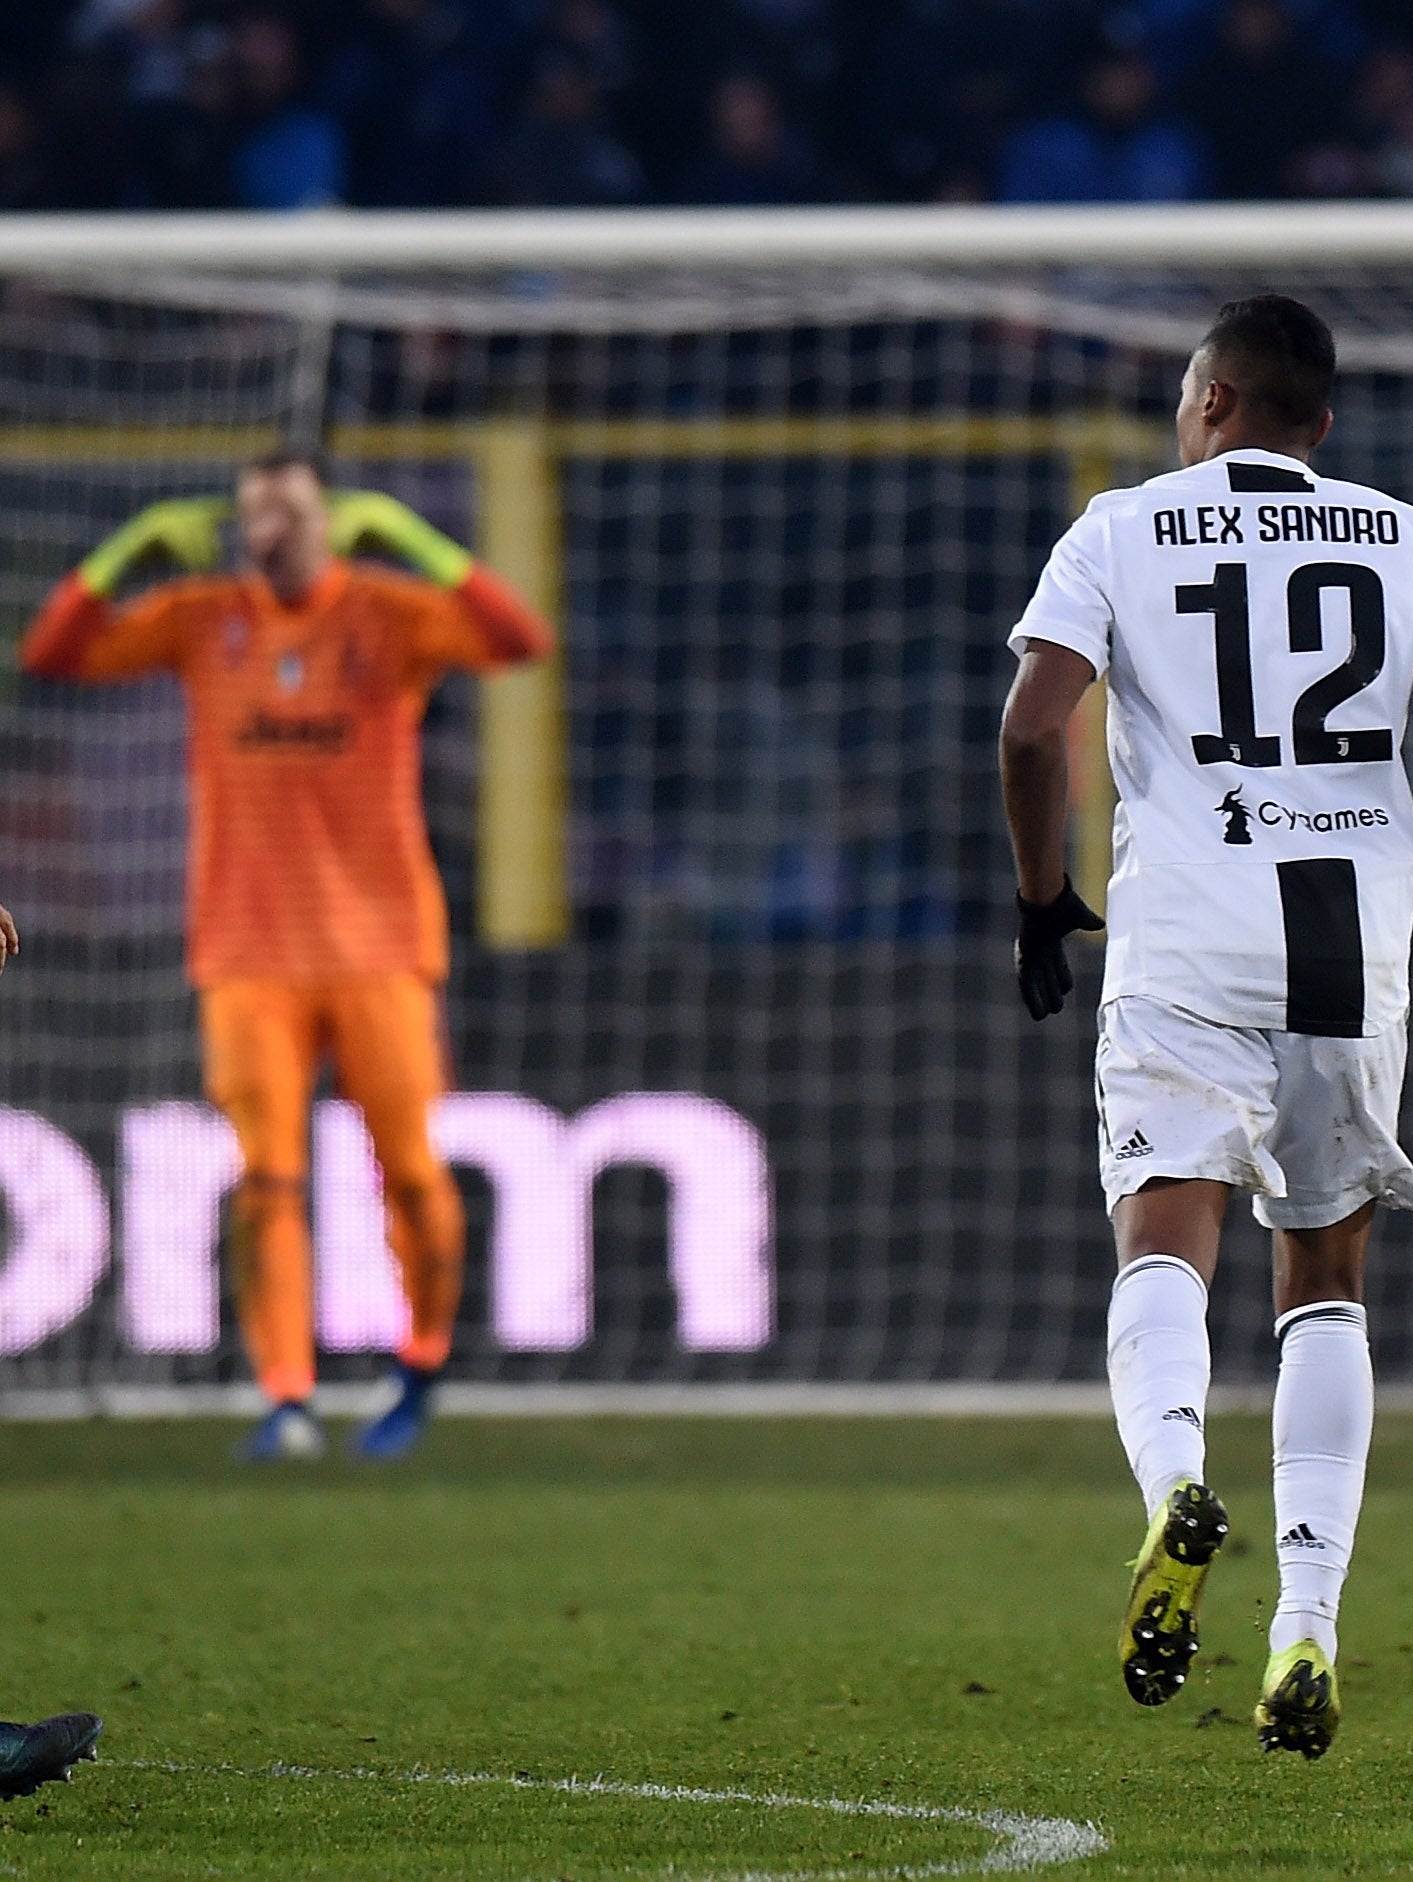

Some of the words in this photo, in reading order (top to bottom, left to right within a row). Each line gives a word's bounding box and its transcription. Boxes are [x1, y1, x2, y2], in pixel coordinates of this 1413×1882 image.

[1153, 505, 1245, 546] ALEX
[1257, 504, 1400, 546] SANDRO
[1174, 561, 1394, 768] 12
